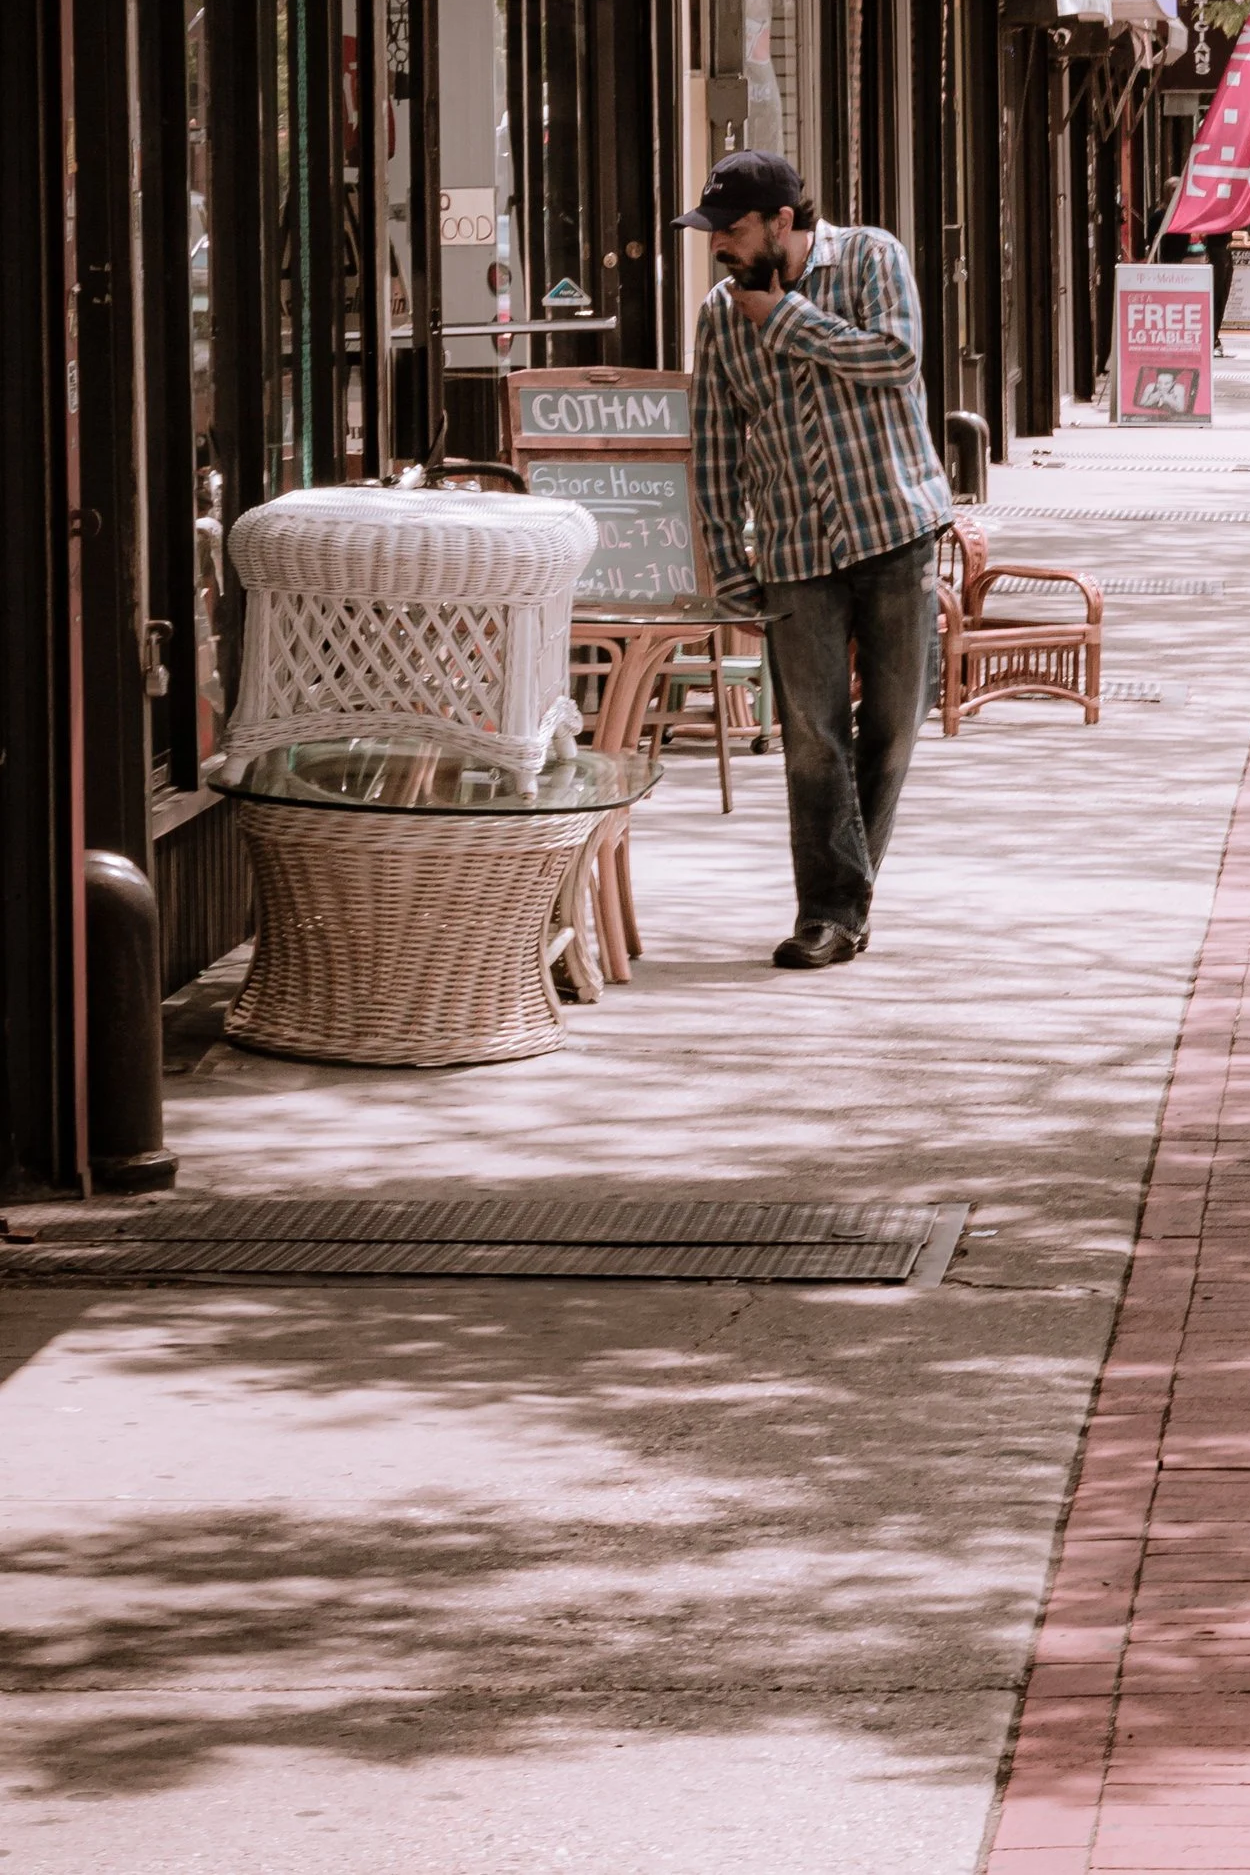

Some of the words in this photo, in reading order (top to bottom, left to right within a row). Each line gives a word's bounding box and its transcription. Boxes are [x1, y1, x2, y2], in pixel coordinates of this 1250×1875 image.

[441, 216, 493, 242] OOD
[1127, 303, 1203, 330] FREE
[1127, 330, 1147, 344] LG
[1149, 330, 1202, 344] TABLET
[531, 393, 671, 433] GOTHAM
[531, 466, 606, 497] Store
[609, 466, 676, 498] Hours
